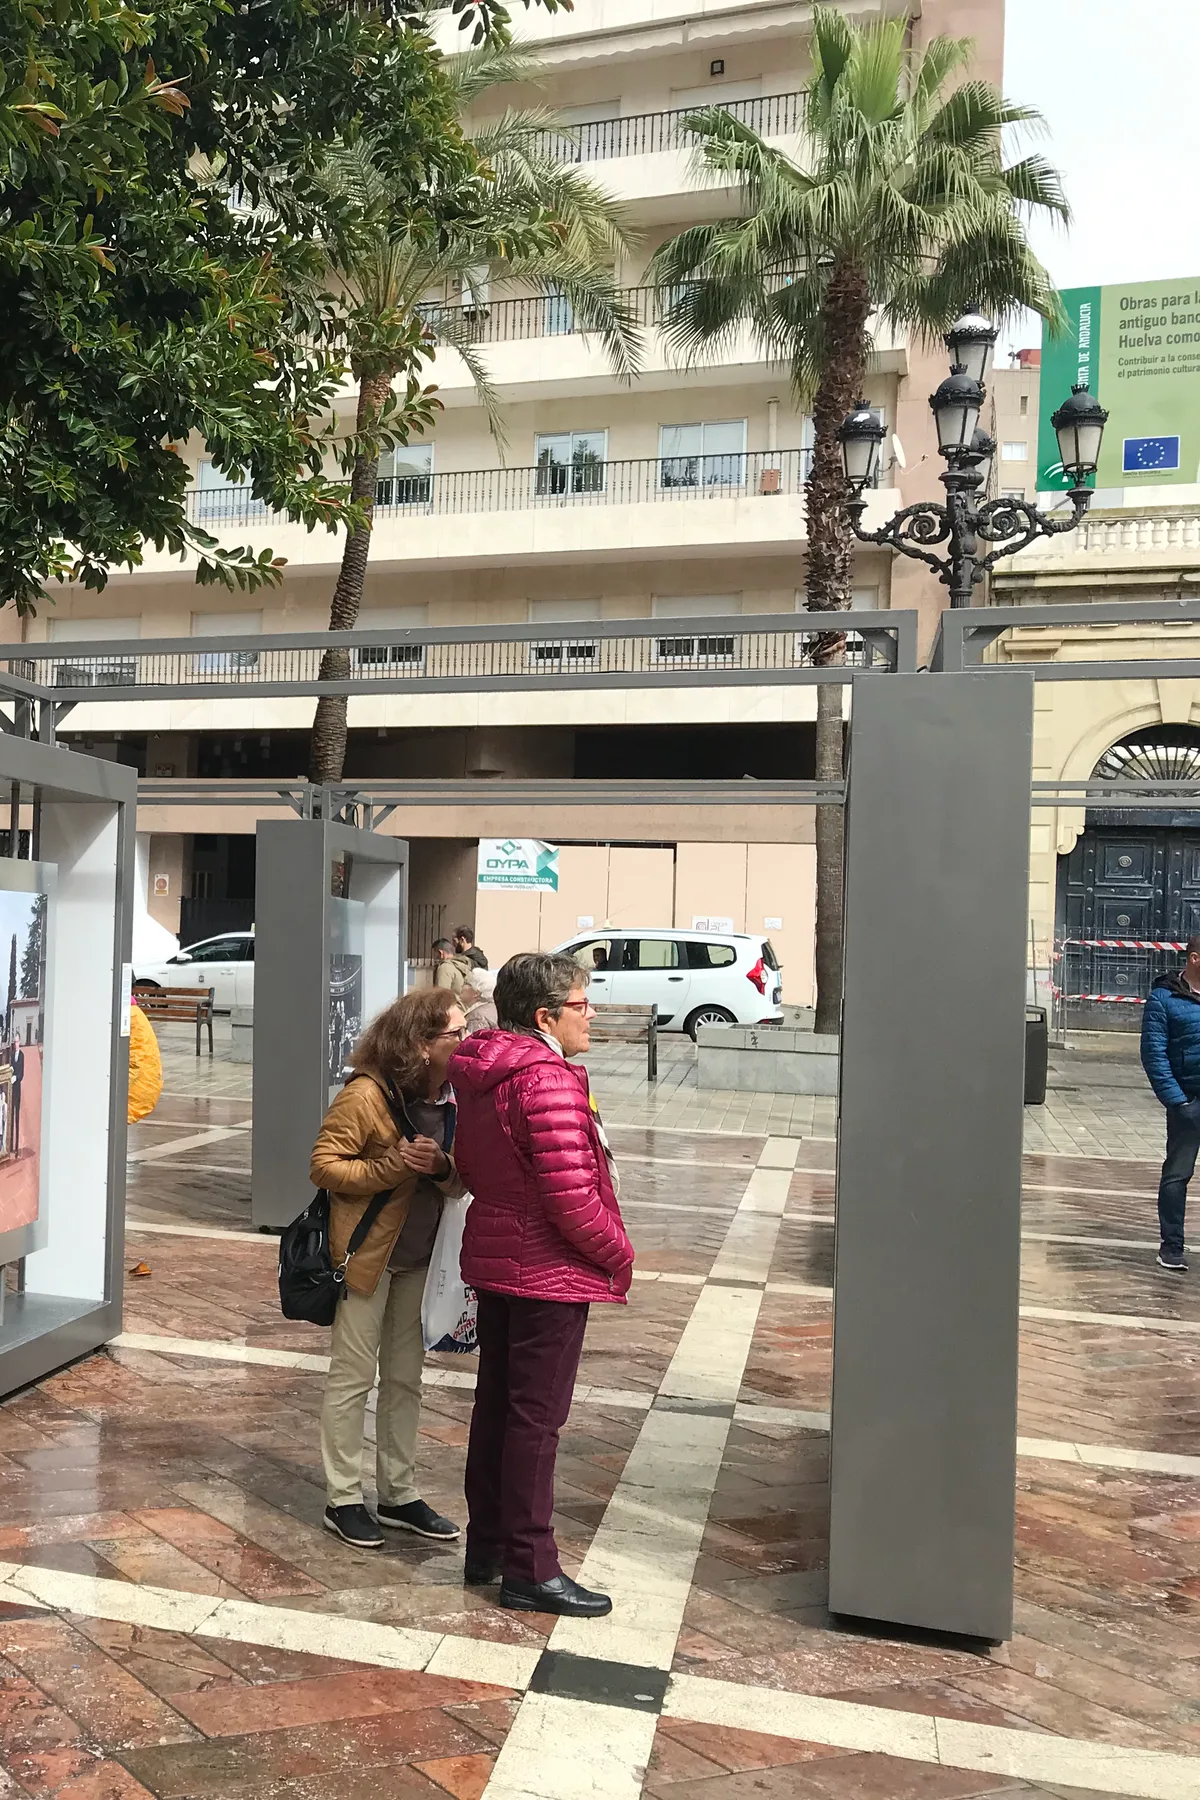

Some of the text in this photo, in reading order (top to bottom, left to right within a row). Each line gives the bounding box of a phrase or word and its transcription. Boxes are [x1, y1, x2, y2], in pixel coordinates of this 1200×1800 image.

[1119, 290, 1200, 311] Obras para l
[1119, 314, 1167, 331] antiguo
[1118, 331, 1200, 348] Huelva como
[1078, 351, 1090, 364] DE
[1117, 355, 1158, 366] Contribuir
[1167, 354, 1176, 363] la
[1077, 365, 1089, 388] UNTA
[1117, 369, 1125, 378] el
[1127, 367, 1170, 379] patrimonio
[486, 858, 529, 869] OYPA
